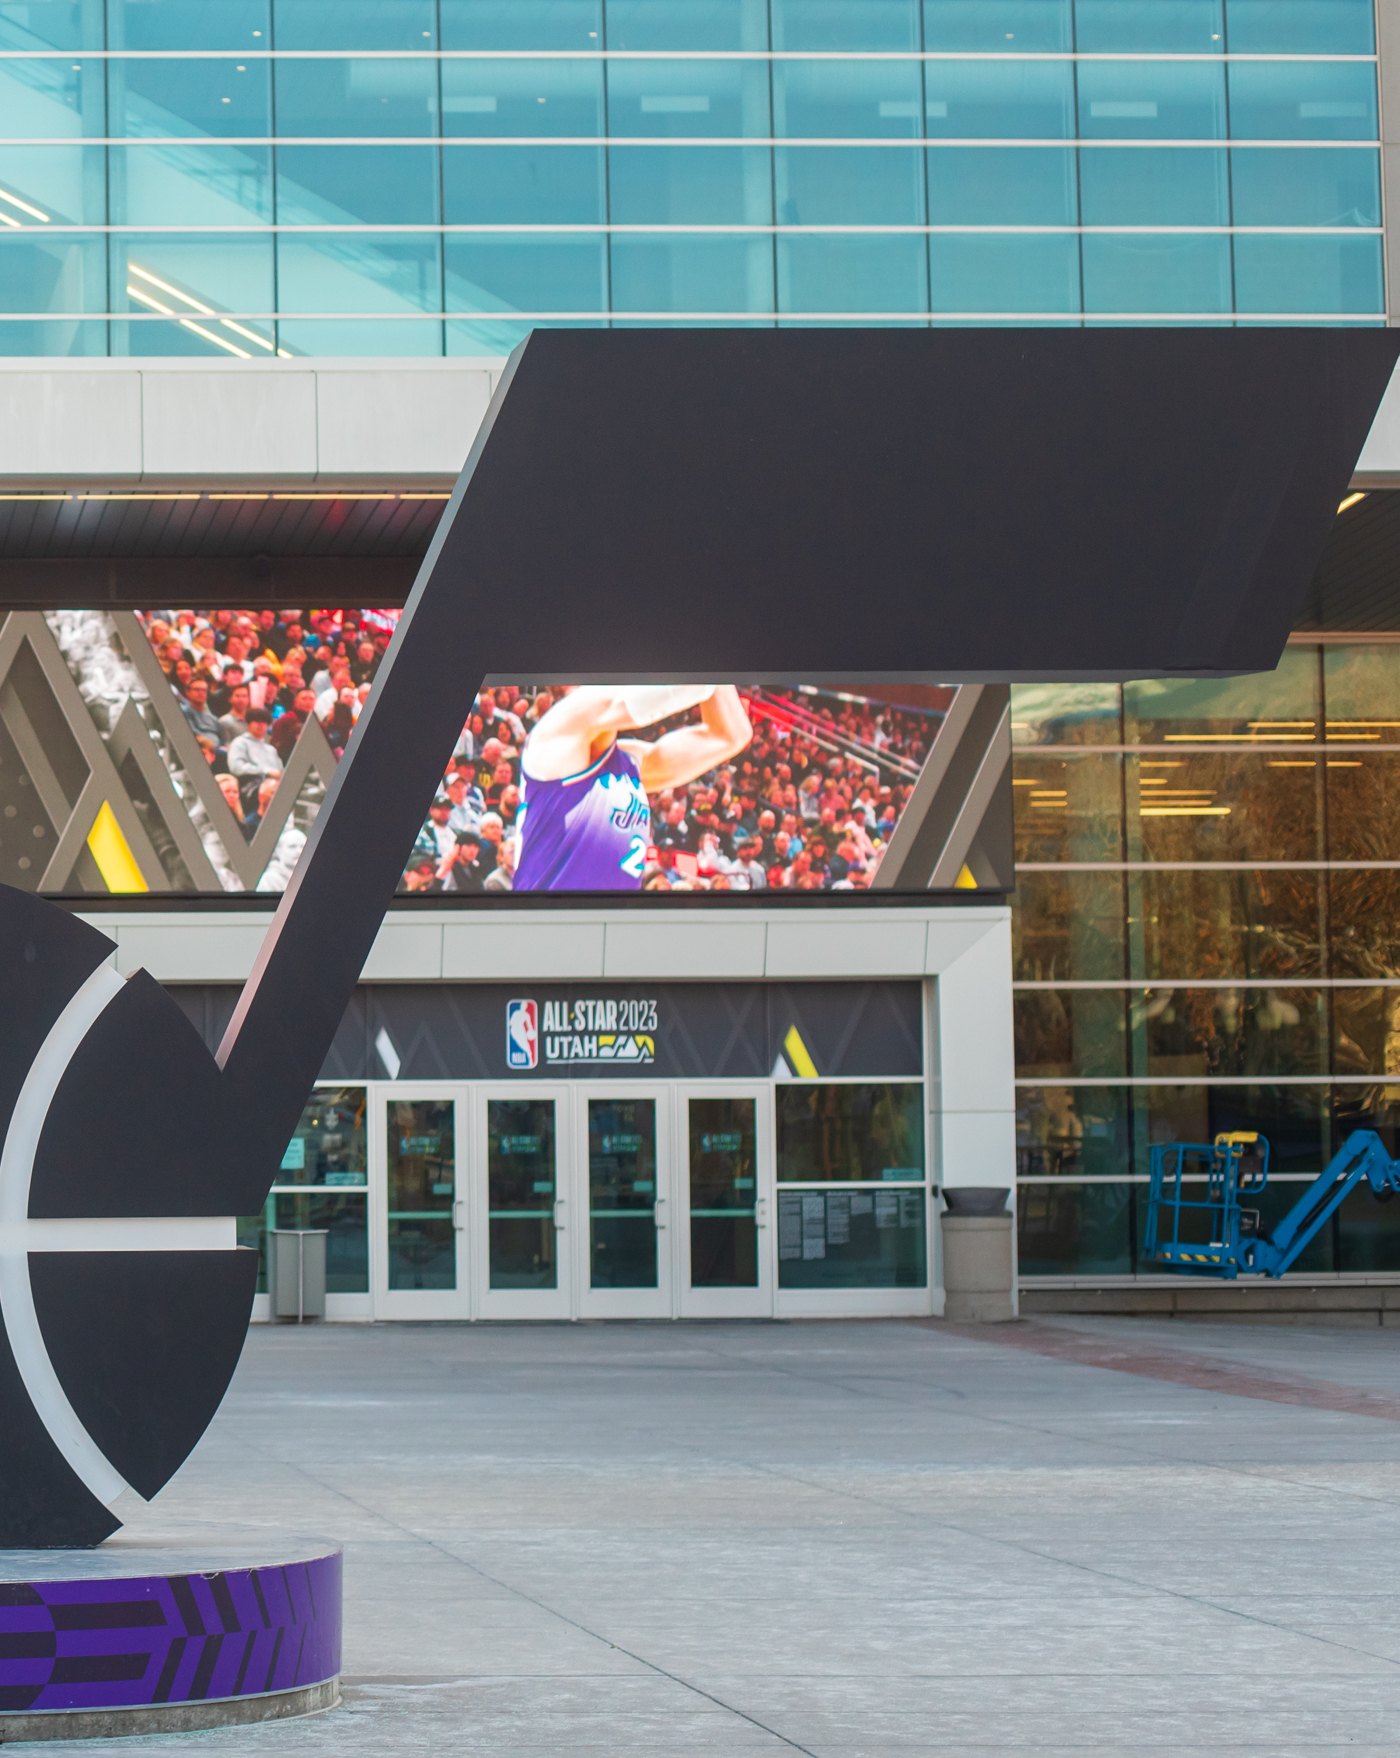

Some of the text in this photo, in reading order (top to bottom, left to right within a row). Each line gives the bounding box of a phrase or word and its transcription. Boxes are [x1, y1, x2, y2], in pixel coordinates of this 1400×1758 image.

[619, 1000, 658, 1031] 2023
[511, 1052, 527, 1064] NBA
[545, 1035, 598, 1059] UTAH
